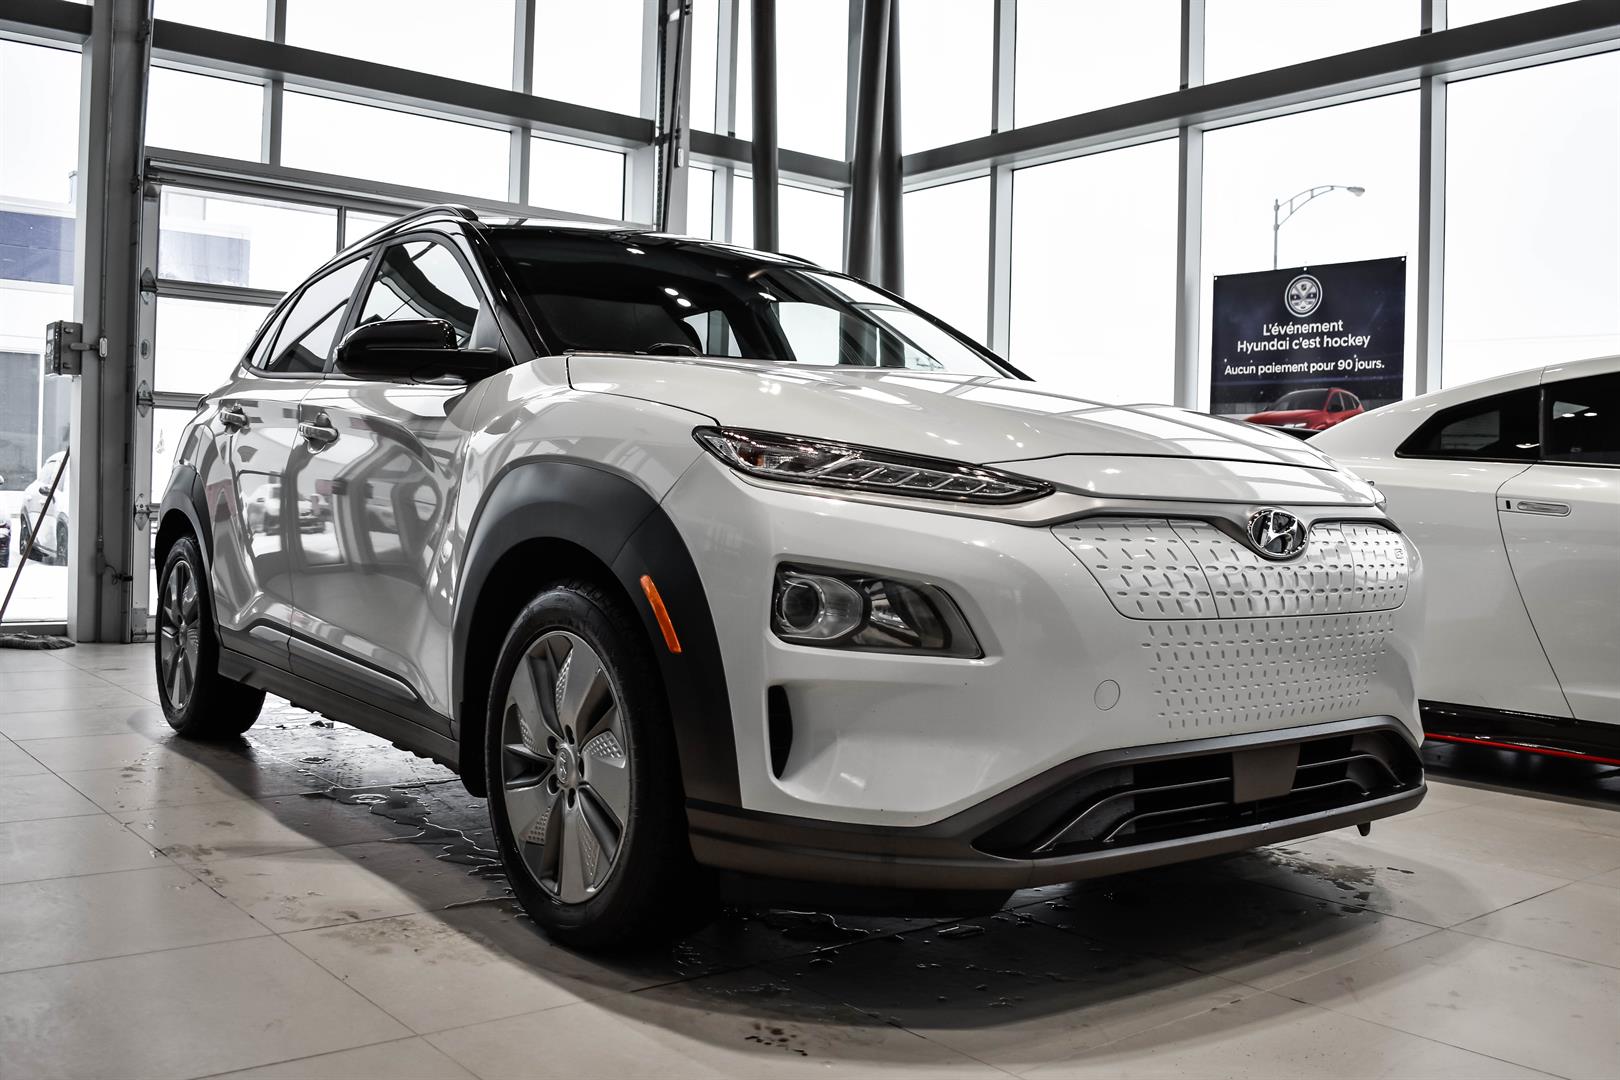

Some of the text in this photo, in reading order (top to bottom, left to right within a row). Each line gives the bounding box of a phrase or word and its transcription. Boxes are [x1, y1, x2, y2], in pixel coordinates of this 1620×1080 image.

[1263, 320, 1344, 336] L'événement
[1237, 334, 1371, 354] Hyundai c'est hockey
[1224, 357, 1385, 375] Aucun paiement pour 90 jours.
